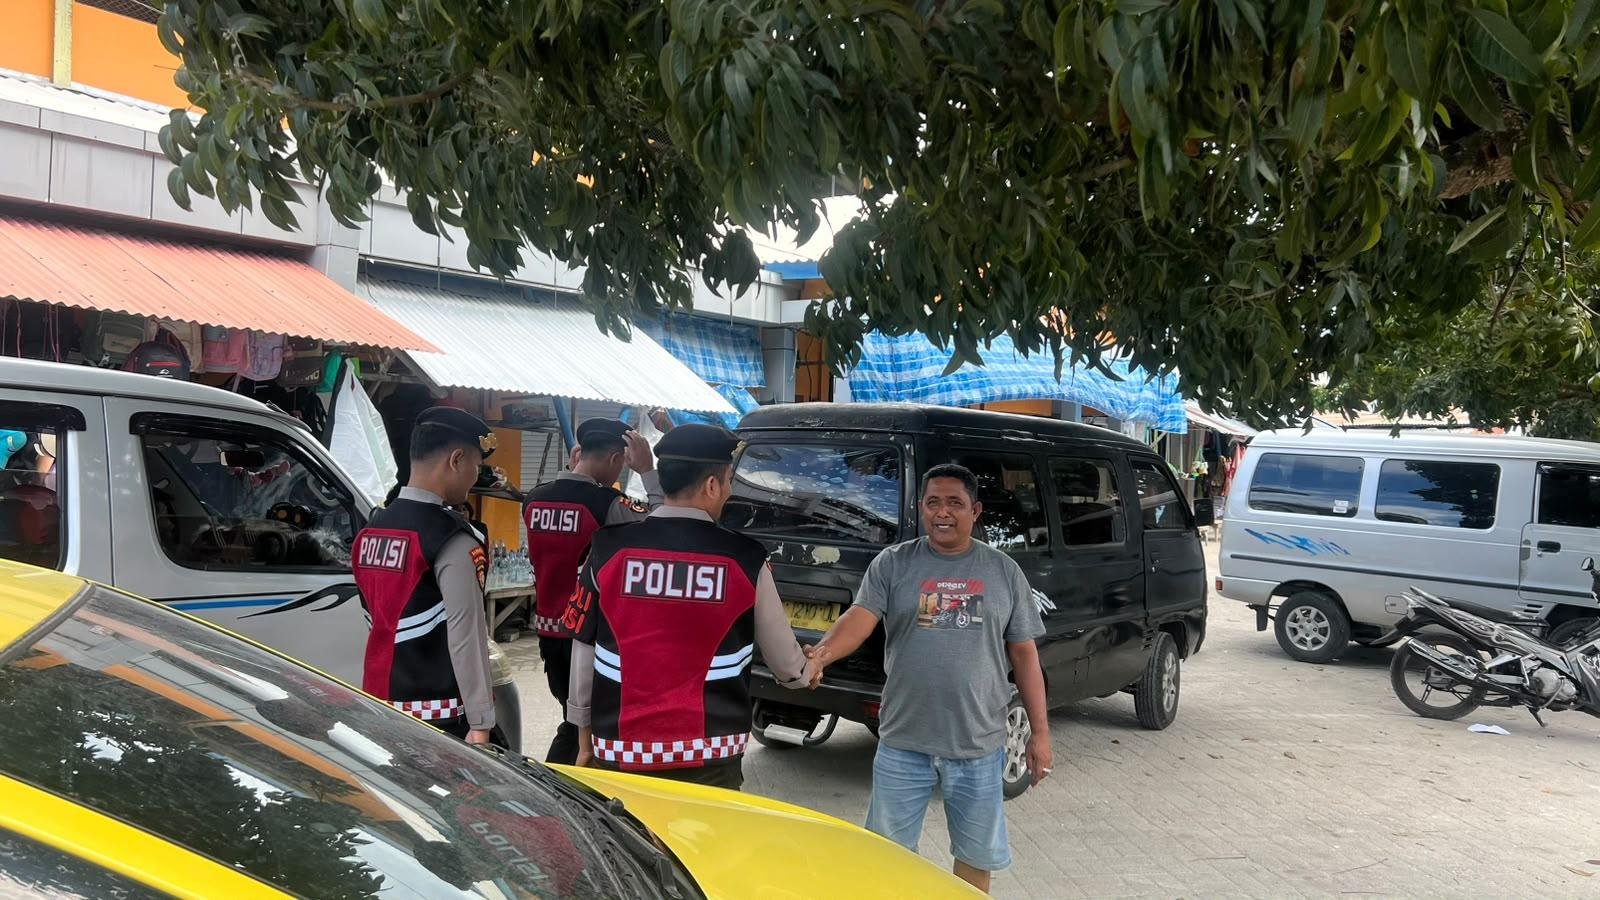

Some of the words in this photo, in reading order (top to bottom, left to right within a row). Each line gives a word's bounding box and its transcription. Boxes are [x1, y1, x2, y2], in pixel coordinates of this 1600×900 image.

[530, 508, 579, 532] POLISI
[360, 537, 406, 569] POLISI
[624, 561, 724, 600] POLISI
